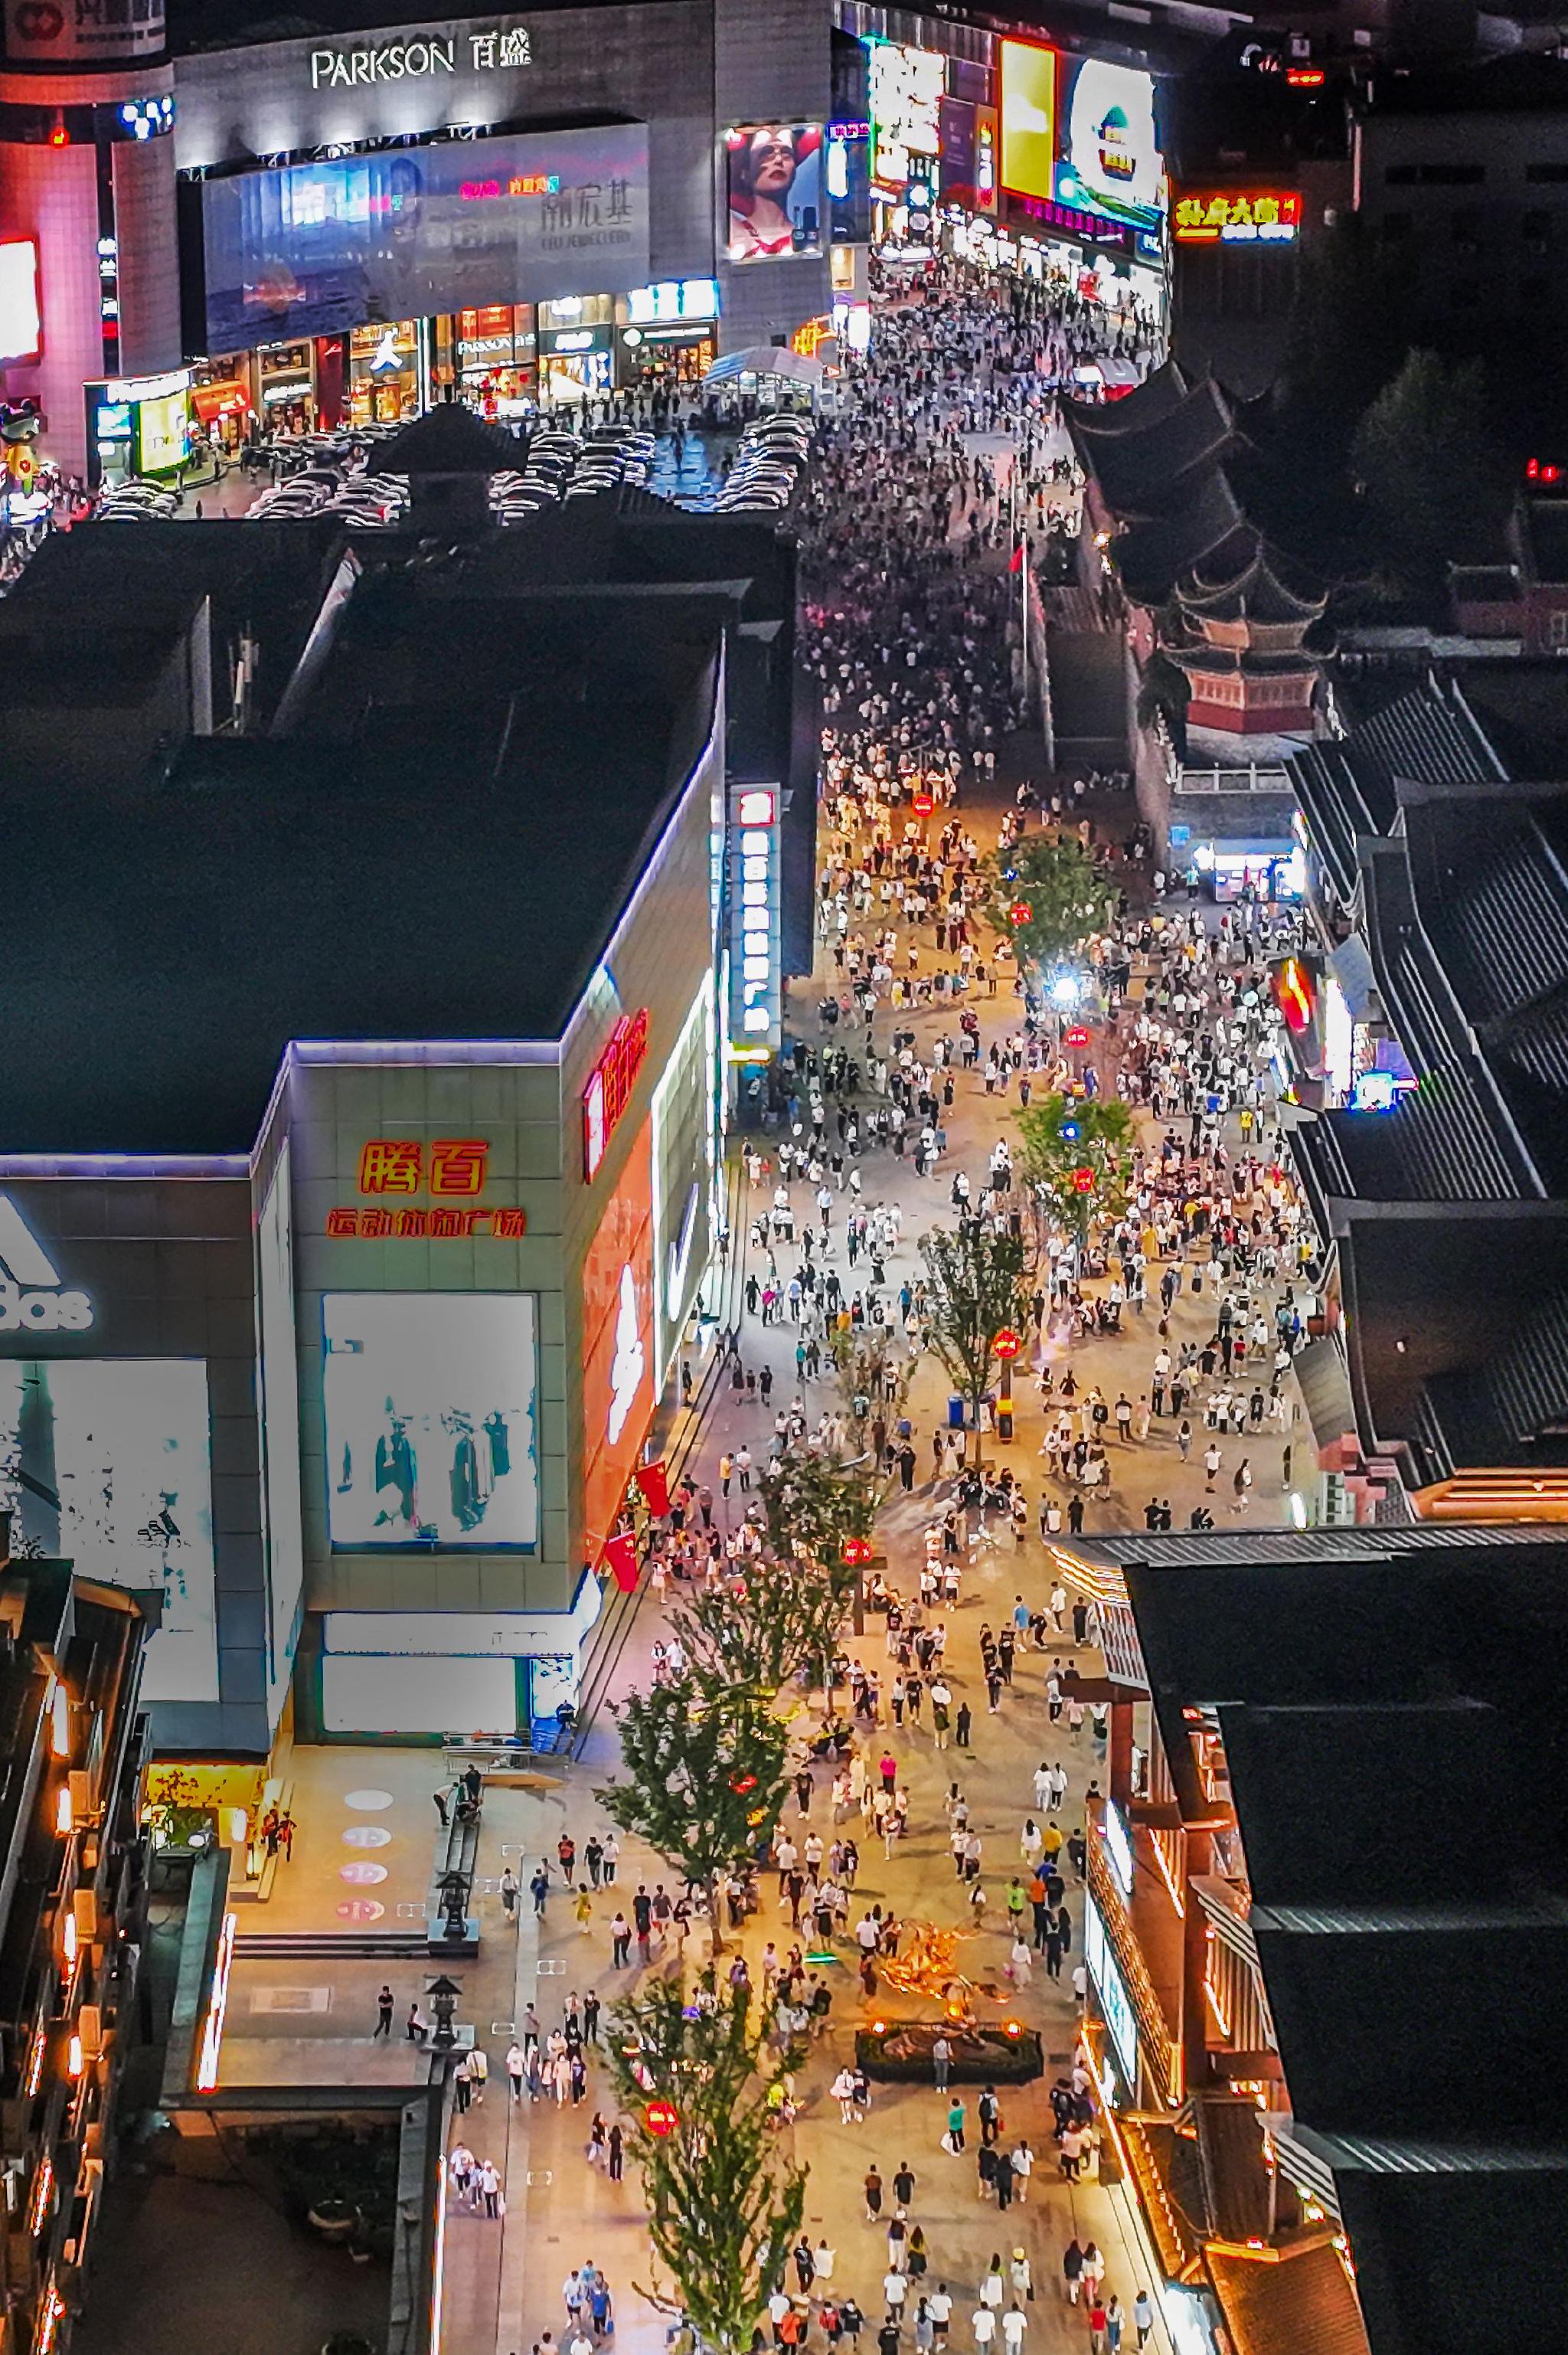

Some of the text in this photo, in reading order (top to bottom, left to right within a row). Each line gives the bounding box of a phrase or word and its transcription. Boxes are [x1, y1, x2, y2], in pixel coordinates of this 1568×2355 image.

[312, 27, 532, 89] PARKSON 百盛
[361, 1140, 490, 1195] 腾百
[326, 1208, 526, 1238] 运动休闲广场
